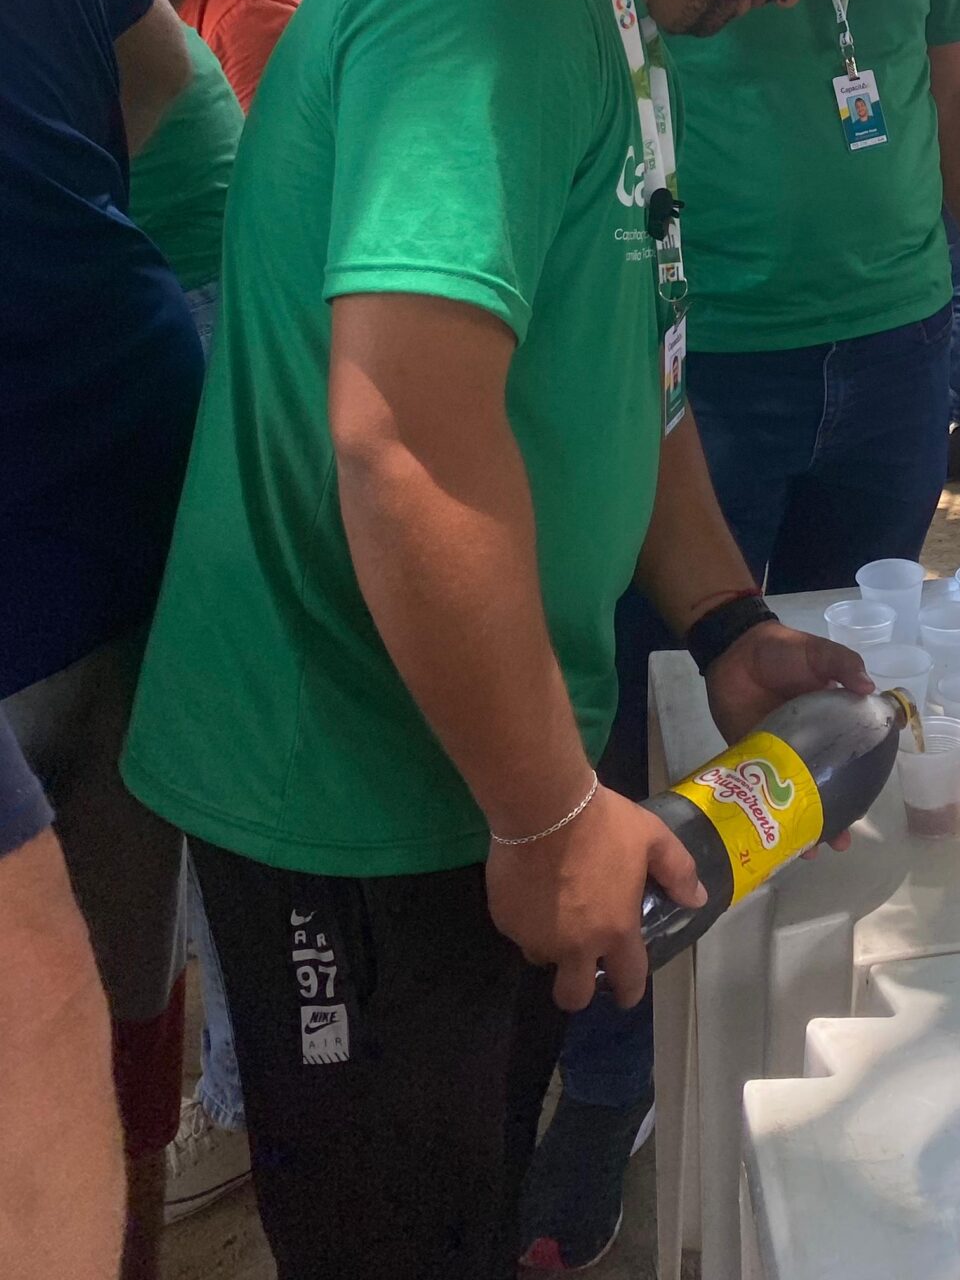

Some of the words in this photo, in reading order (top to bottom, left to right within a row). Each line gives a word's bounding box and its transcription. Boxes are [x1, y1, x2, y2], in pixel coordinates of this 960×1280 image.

[701, 768, 775, 844] Cruzeirense
[296, 965, 338, 999] 97
[310, 1011, 337, 1024] NIKE
